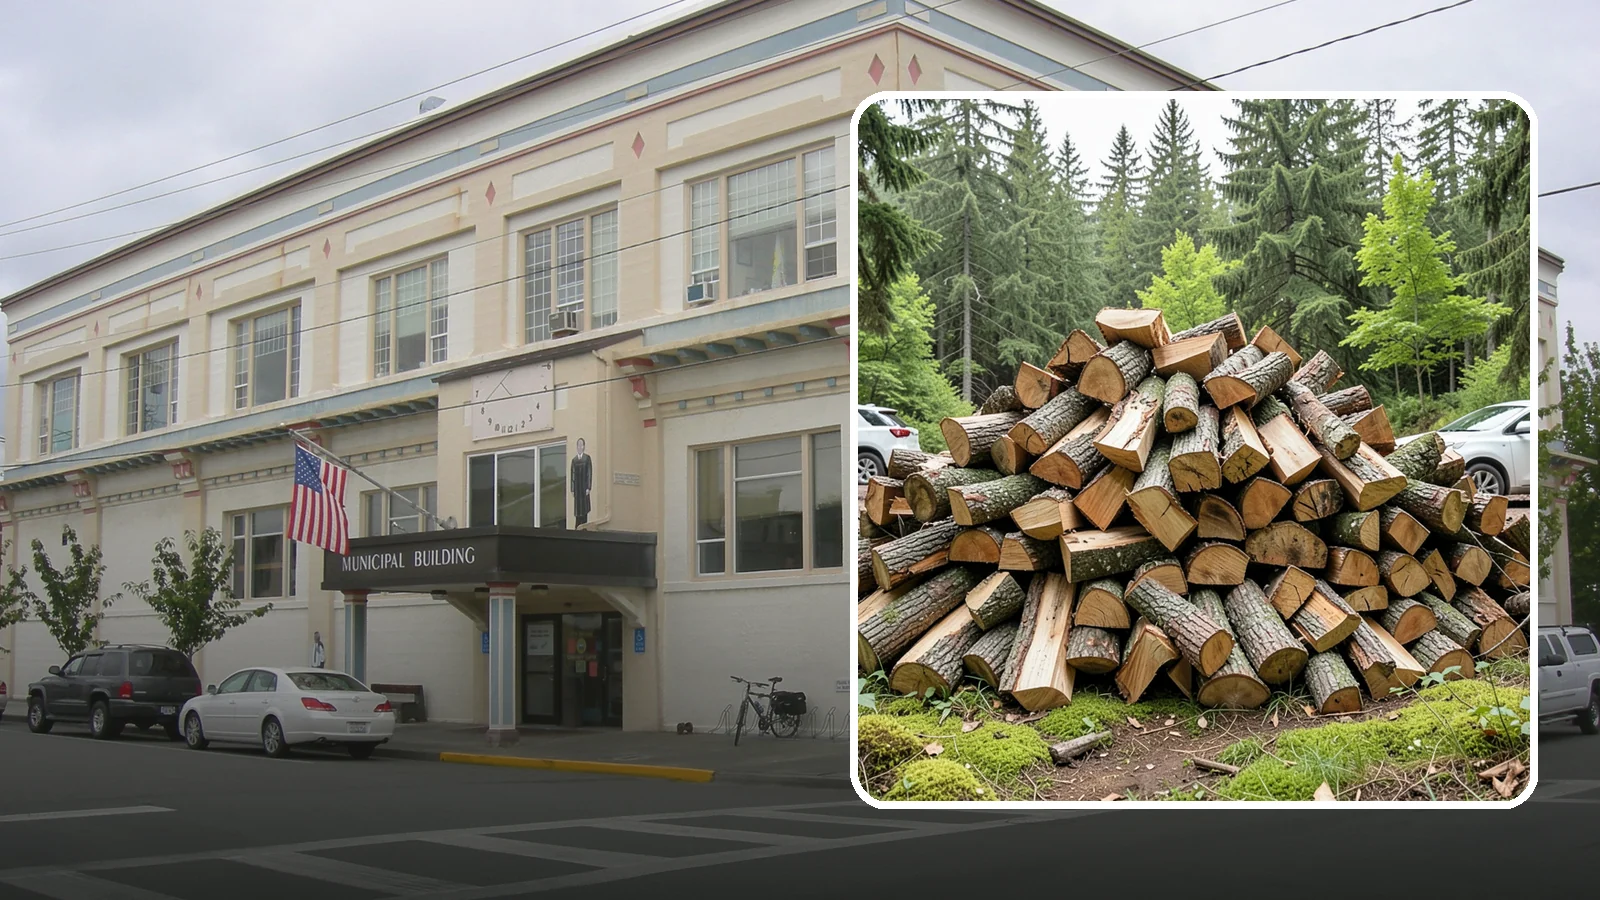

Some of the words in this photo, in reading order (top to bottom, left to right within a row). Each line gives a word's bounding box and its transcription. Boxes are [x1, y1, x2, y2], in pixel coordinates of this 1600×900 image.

[536, 402, 540, 410] 4
[481, 407, 485, 415] 8
[488, 418, 492, 426] 9
[529, 414, 533, 422] 3
[495, 424, 500, 432] 10
[521, 420, 525, 428] 2
[501, 426, 506, 434] 11
[507, 425, 513, 433] 12
[342, 552, 405, 572] MUNICIPAL
[414, 546, 475, 567] BUILDING
